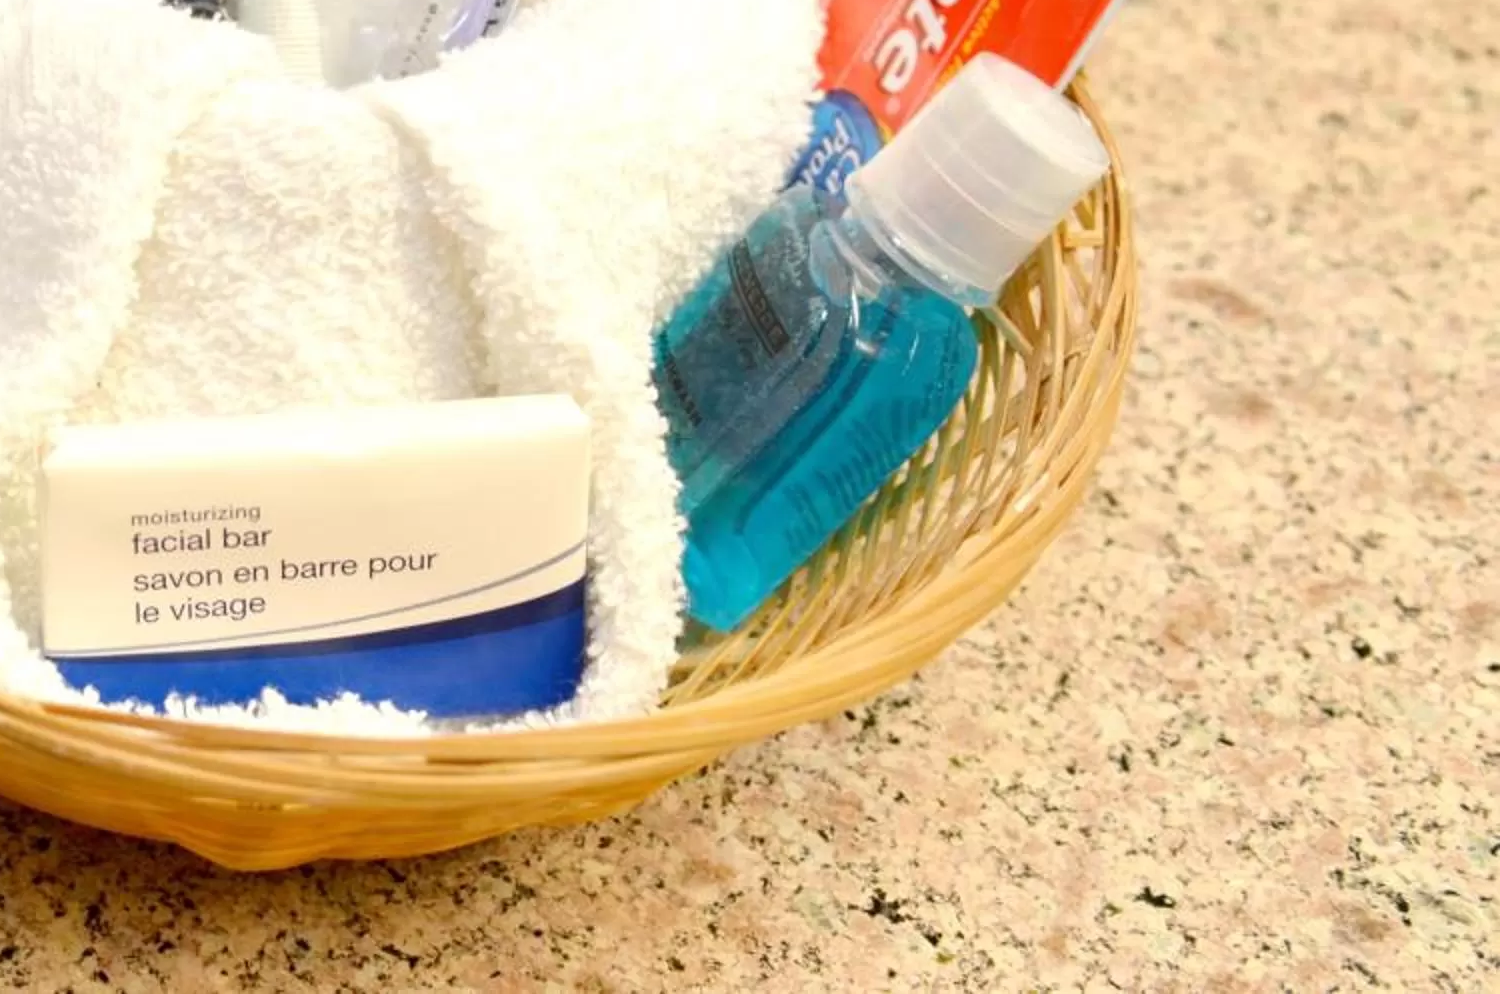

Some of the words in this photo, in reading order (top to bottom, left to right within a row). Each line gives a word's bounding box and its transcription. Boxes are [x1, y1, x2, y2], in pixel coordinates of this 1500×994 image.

[131, 505, 262, 527] moisturizing
[132, 529, 211, 555] facial
[223, 525, 273, 549] bar
[133, 565, 223, 592] savon
[233, 563, 269, 584] en
[280, 555, 358, 581] barre
[368, 550, 438, 579] pour
[134, 601, 160, 624] le
[170, 592, 267, 621] visage
